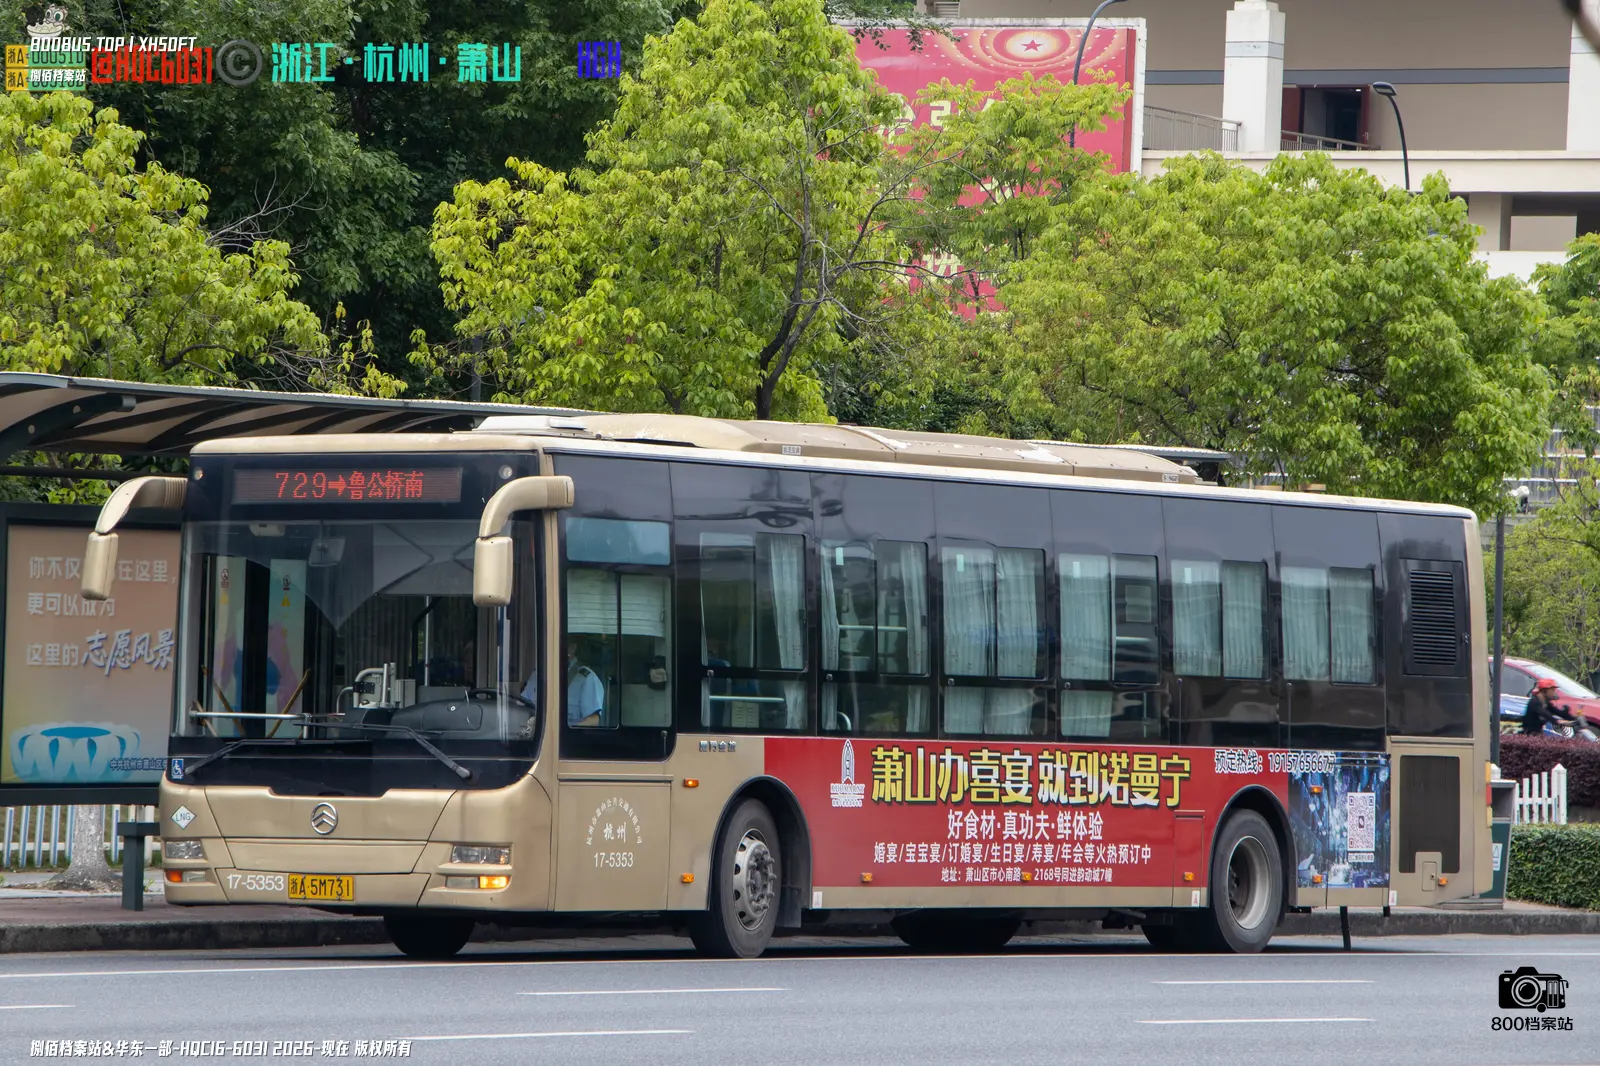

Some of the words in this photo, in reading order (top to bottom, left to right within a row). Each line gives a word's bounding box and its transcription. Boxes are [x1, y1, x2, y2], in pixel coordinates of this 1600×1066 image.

[275, 472, 326, 498] 729
[347, 471, 424, 500] 鲁公桥南
[870, 745, 1033, 805] 萧山办喜宴
[1037, 748, 1192, 809] 就到诺曼宁
[176, 812, 191, 821] LNG
[947, 809, 1104, 841] 好食材·真功夫·鲜体验
[603, 821, 627, 843] 杭州
[594, 851, 634, 867] 17-5353
[227, 873, 284, 891] 17-5353
